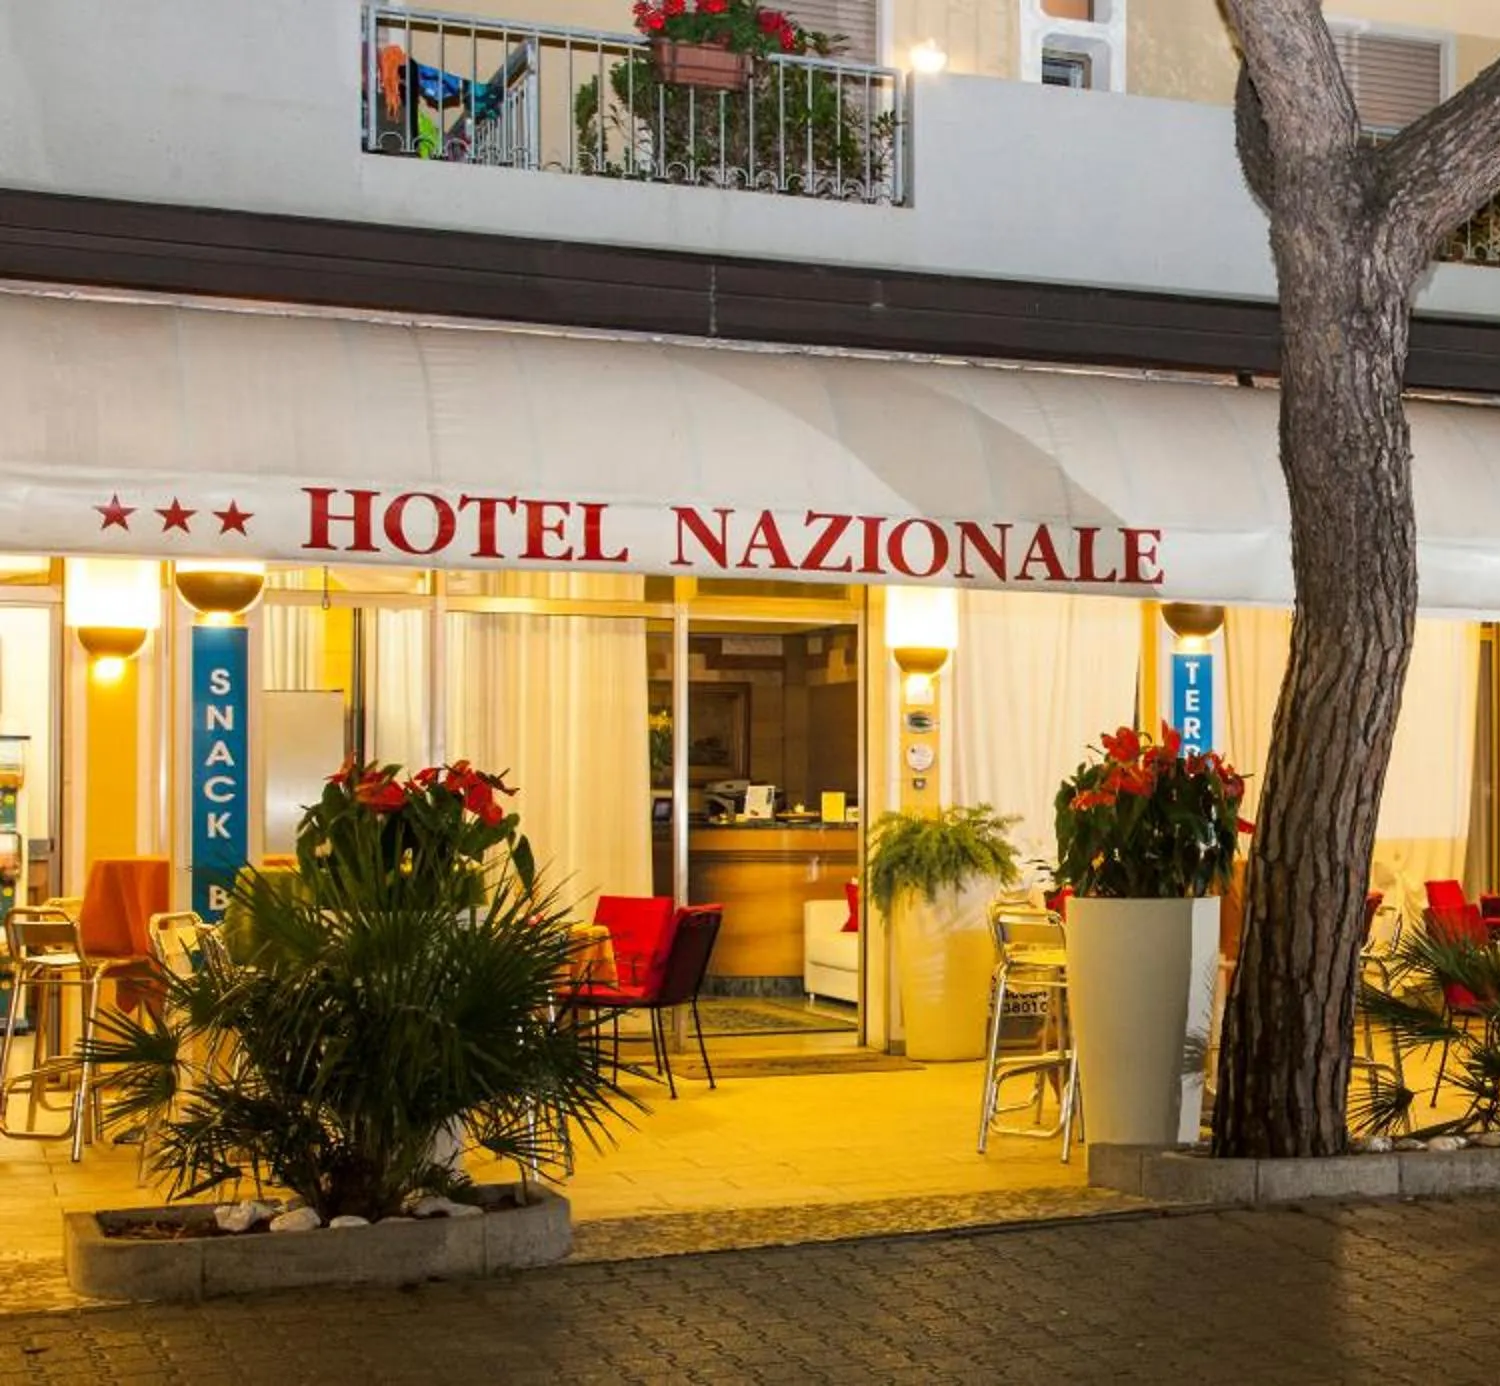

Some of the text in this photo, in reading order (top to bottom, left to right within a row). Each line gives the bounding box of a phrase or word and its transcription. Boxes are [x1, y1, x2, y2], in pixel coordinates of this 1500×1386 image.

[302, 487, 1165, 585] HOTEL NAZIONALE
[203, 667, 236, 839] SNACK
